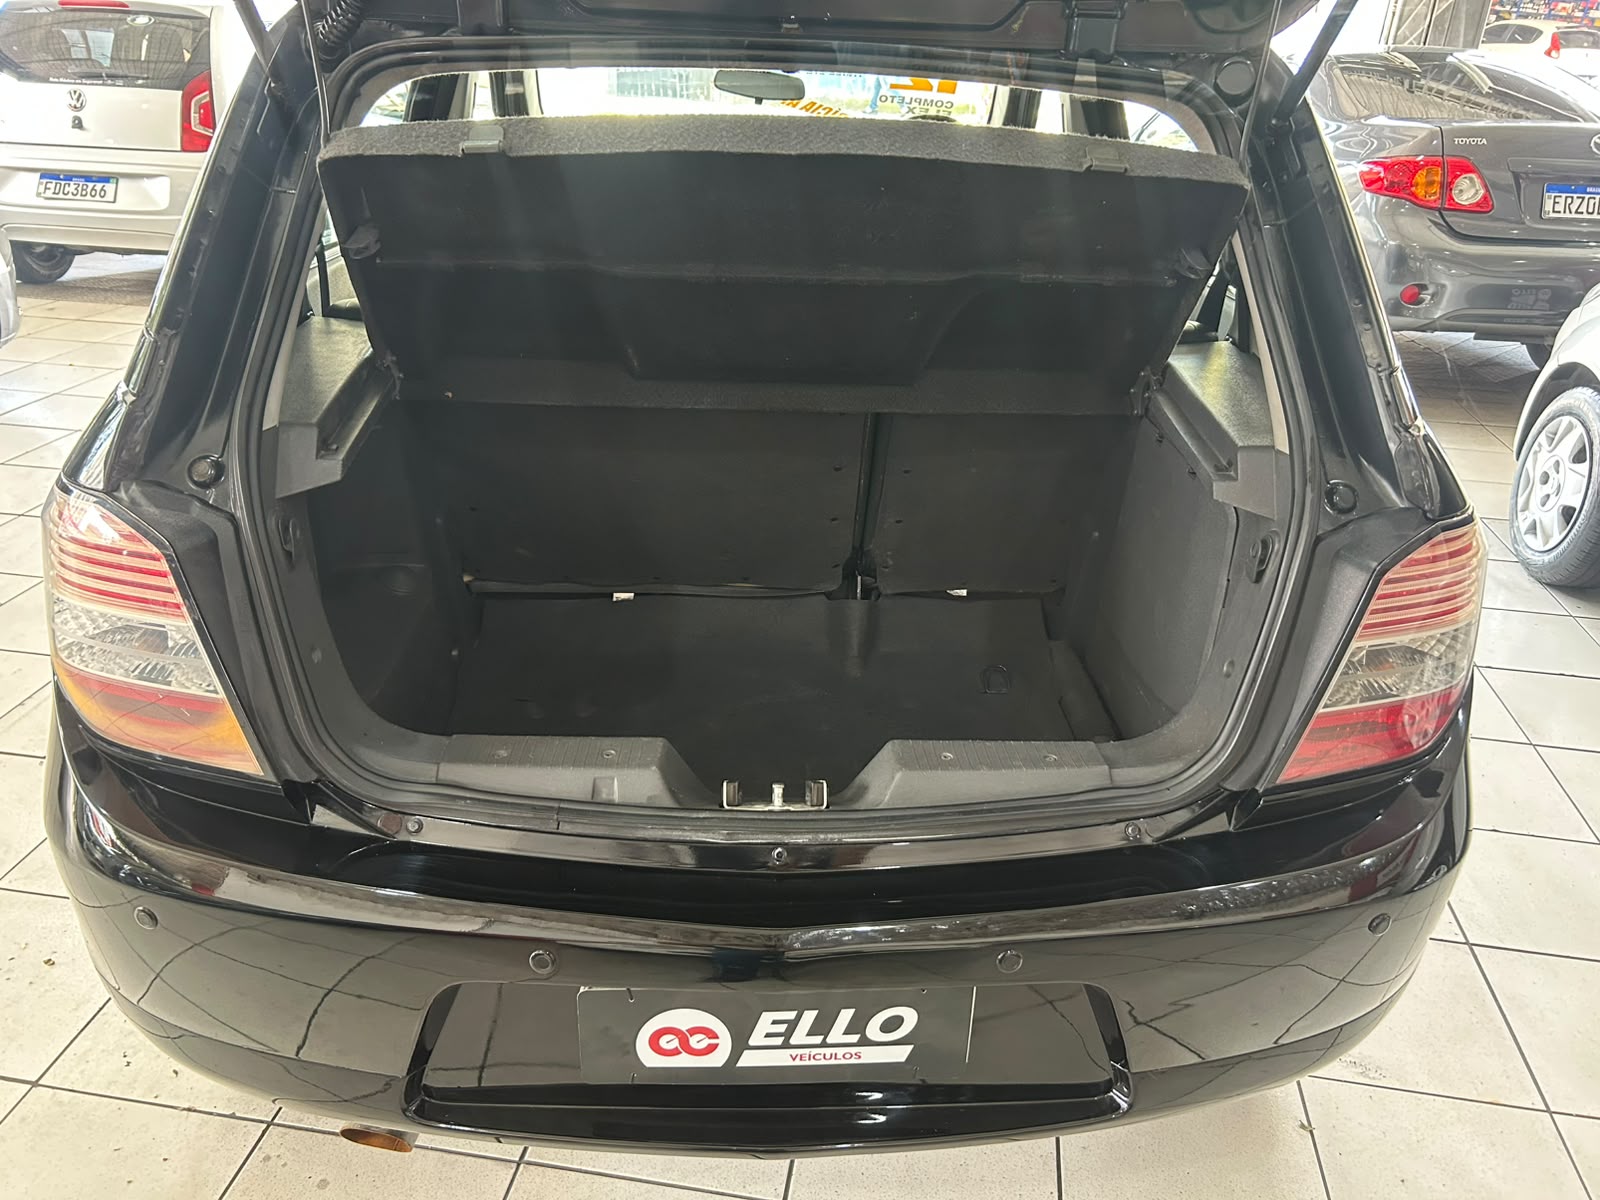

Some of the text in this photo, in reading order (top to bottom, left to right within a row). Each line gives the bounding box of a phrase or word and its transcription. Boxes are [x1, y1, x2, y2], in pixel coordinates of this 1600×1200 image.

[43, 180, 107, 199] FDC3B66
[747, 1006, 919, 1047] ELLO
[789, 1050, 862, 1063] VEÍCULOS
